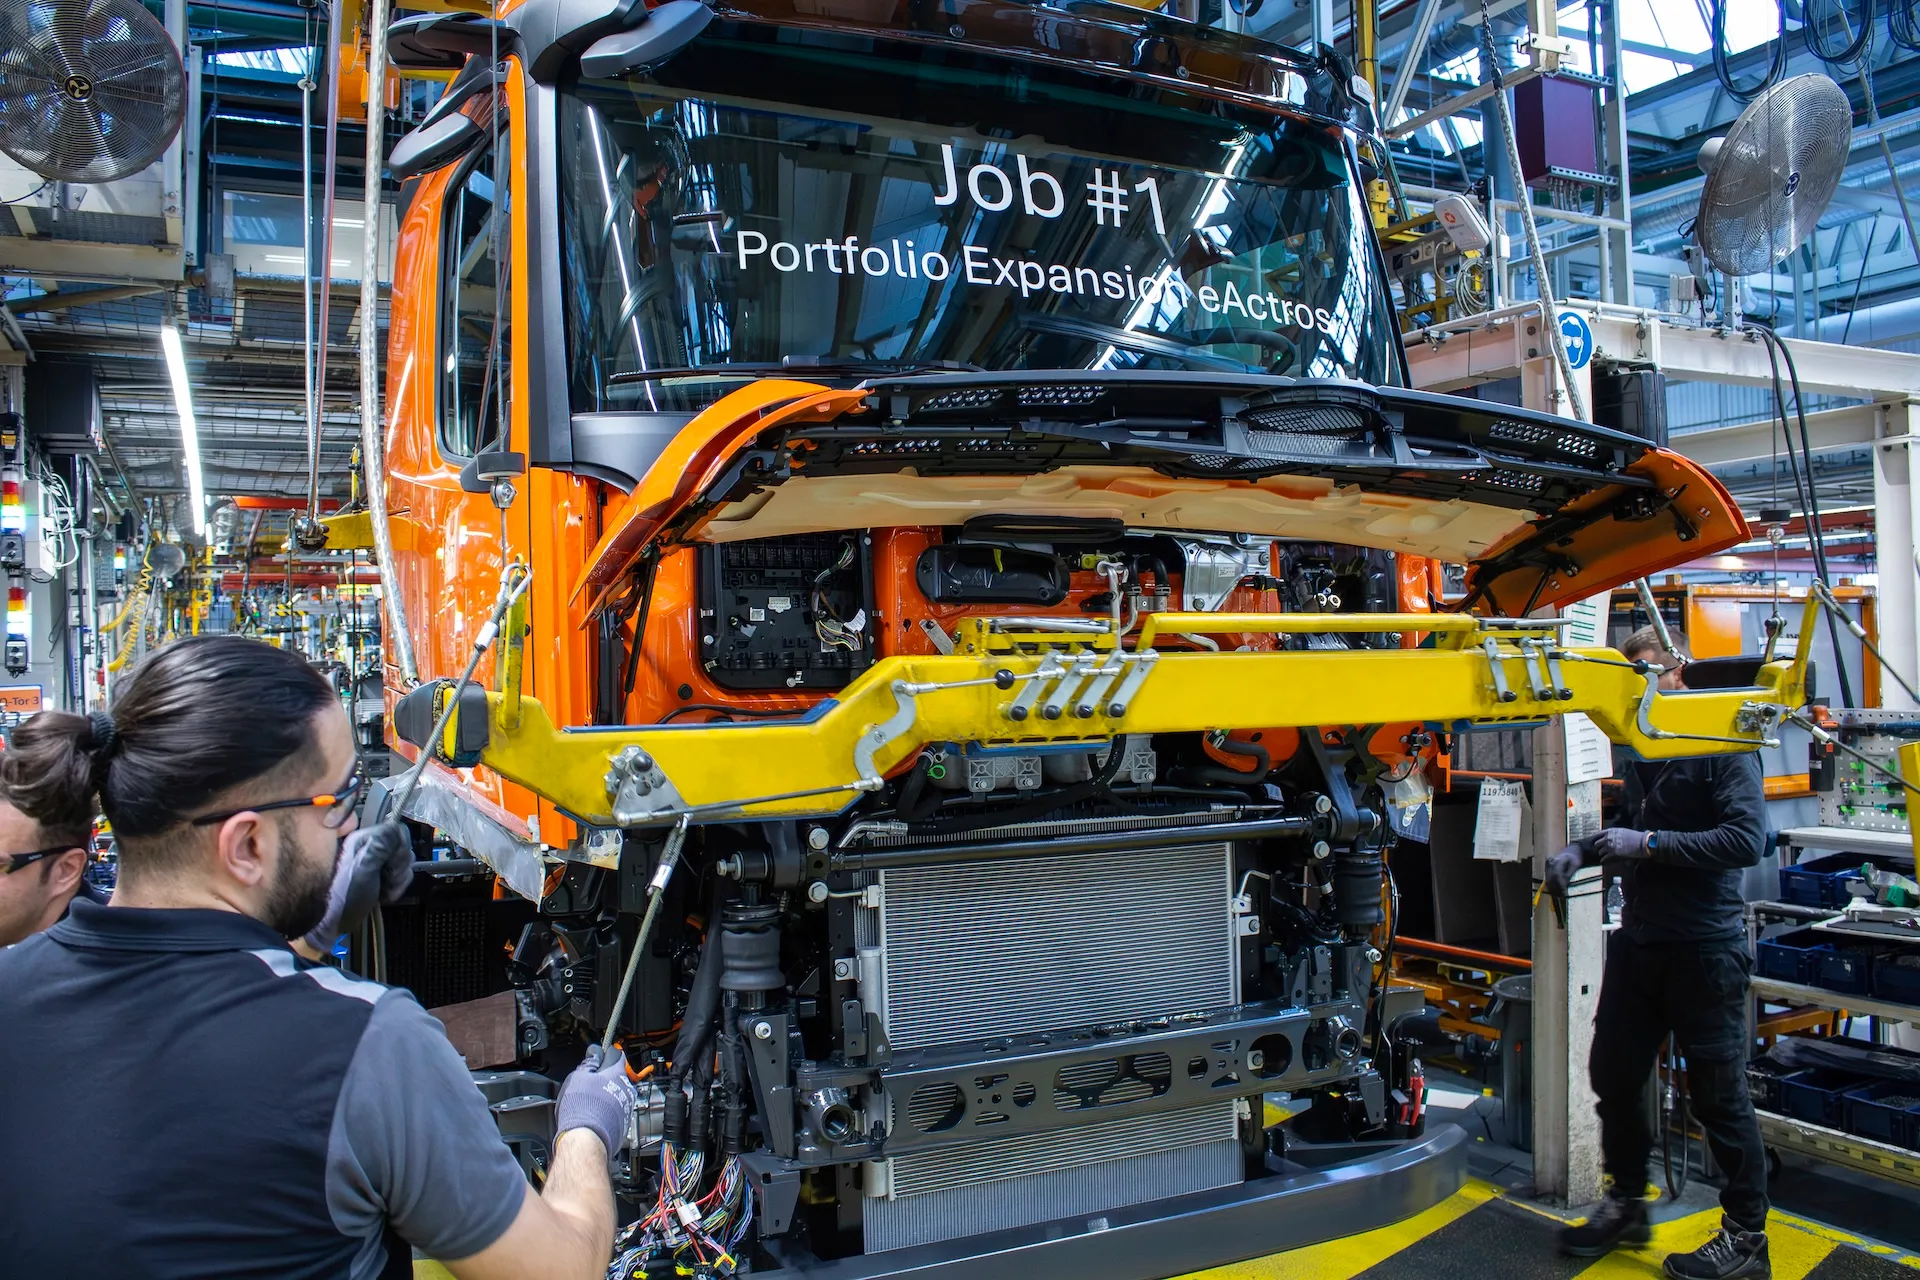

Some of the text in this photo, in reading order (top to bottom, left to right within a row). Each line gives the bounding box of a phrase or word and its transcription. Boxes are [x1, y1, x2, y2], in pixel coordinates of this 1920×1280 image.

[934, 143, 1166, 235] Job #1
[736, 230, 1332, 335] Portfolio Expansion eActros
[32, 696, 39, 705] 3
